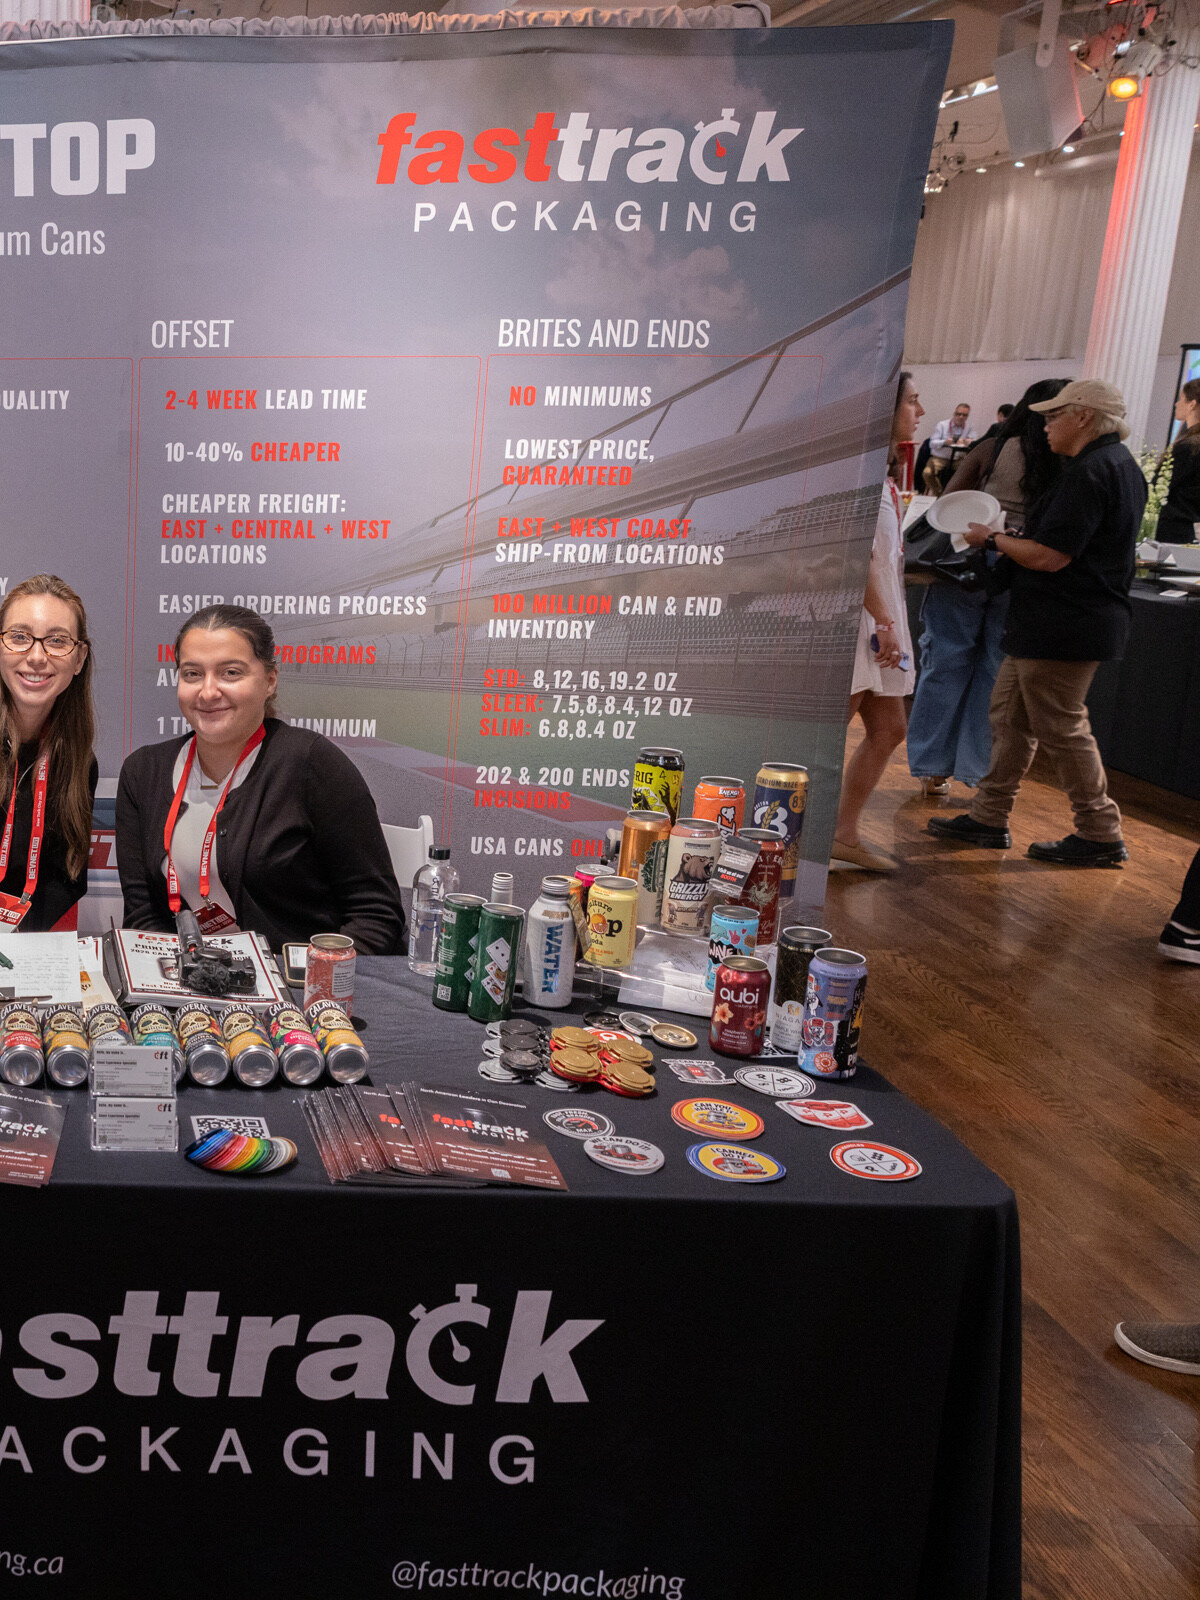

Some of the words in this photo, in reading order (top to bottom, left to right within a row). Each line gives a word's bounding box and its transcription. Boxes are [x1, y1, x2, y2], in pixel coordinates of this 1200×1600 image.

[376, 108, 805, 186] fasttrack
[414, 201, 759, 233] PACKAGING
[41, 222, 105, 257] Cans
[151, 319, 234, 349] OFFSET
[498, 319, 581, 348] BRITES
[589, 319, 637, 348] AND
[646, 319, 710, 348] ENDS
[166, 390, 199, 410] 2-4
[207, 390, 257, 410] WEEK
[265, 389, 312, 409] LEAD
[321, 389, 368, 409] TIME
[509, 386, 536, 406] NO
[544, 386, 652, 406] MINIMUMS
[165, 442, 243, 462] 10-40%
[251, 442, 341, 462] CHEAPER
[505, 439, 582, 459] LOWEST
[588, 439, 655, 462] PRICE,
[502, 465, 632, 486] GUARANTEED
[162, 494, 250, 513] CHEAPER
[259, 494, 346, 513] FREIGHT:
[161, 520, 207, 538] EAST
[214, 524, 224, 534] +
[232, 520, 316, 539] CENTRAL
[324, 524, 334, 535] +
[342, 520, 391, 539] WEST
[498, 517, 545, 537] EAST
[570, 518, 621, 537] WEST
[627, 518, 692, 538] COAST
[161, 544, 267, 564] LOCATIONS
[495, 543, 607, 563] SHIP-FROM
[615, 544, 725, 565] LOCATIONS
[339, 596, 427, 615] PROCESS
[492, 594, 524, 613] 100
[532, 594, 612, 614] MILLION
[618, 595, 657, 615] CAN
[665, 596, 677, 616] &
[685, 597, 722, 616] END
[488, 619, 595, 639] INVENTORY
[273, 645, 376, 664] PROGRAMS
[484, 669, 526, 687] STD:
[654, 672, 677, 691] OZ
[482, 694, 544, 712] SLEEK:
[669, 697, 693, 716] OZ
[290, 719, 377, 738] MINIMUM
[480, 718, 531, 736] SLIM:
[613, 721, 636, 739] OZ
[476, 766, 512, 784] 202
[518, 767, 530, 785] &
[539, 767, 574, 785] 200
[582, 768, 630, 787] ENDS
[474, 790, 571, 809] INCISIONS
[3, 824, 12, 854] BEVNET
[471, 837, 506, 855] USA
[515, 838, 564, 856] CANS
[29, 848, 39, 879] BEVNET
[201, 844, 210, 876] BEVNET
[720, 874, 737, 882] BOOTH
[134, 943, 163, 952] PRINT
[710, 942, 734, 959] WAVE
[542, 924, 563, 993] WATER
[432, 1114, 529, 1139] fasttrack
[444, 1124, 525, 1142] PACKAGING
[716, 1148, 755, 1159] CANNED
[392, 1560, 685, 1600] @fasttrackpackaging
